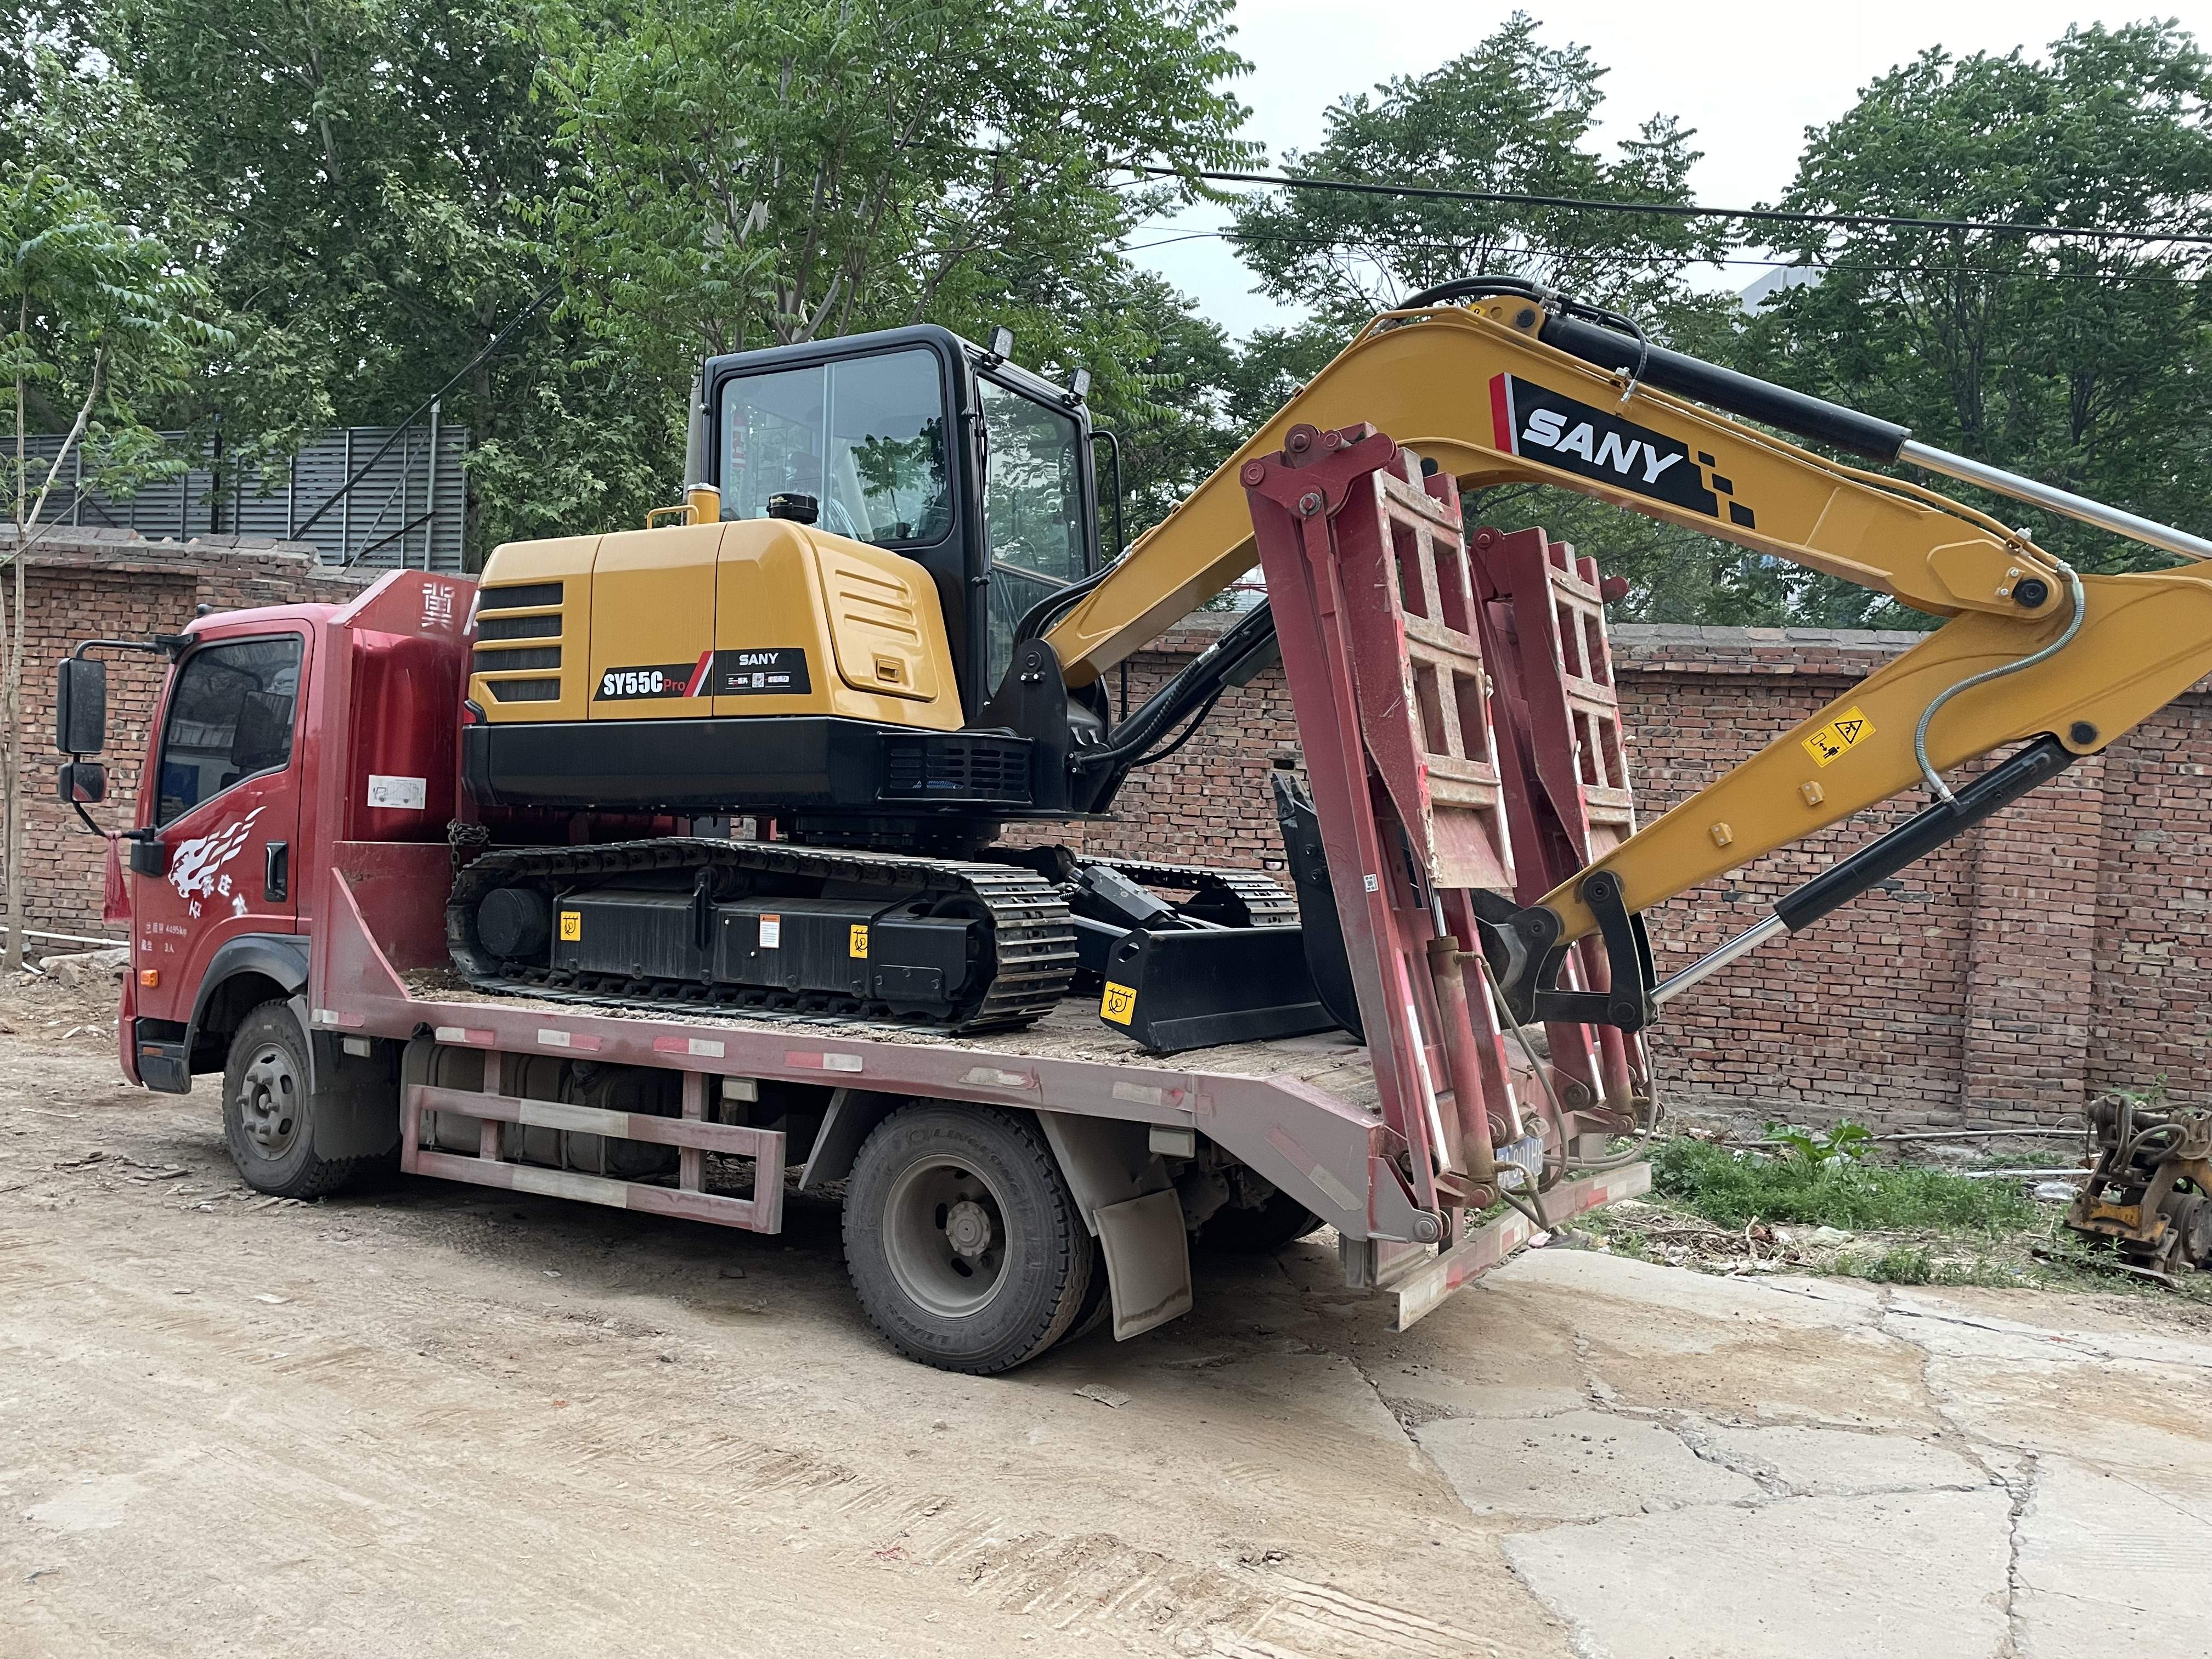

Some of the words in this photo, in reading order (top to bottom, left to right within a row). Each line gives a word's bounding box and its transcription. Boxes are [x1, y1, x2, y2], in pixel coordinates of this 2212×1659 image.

[1522, 408, 1684, 484] SANY
[738, 652, 779, 665] SANY
[603, 671, 663, 696] SY55C
[663, 678, 686, 692] Pro
